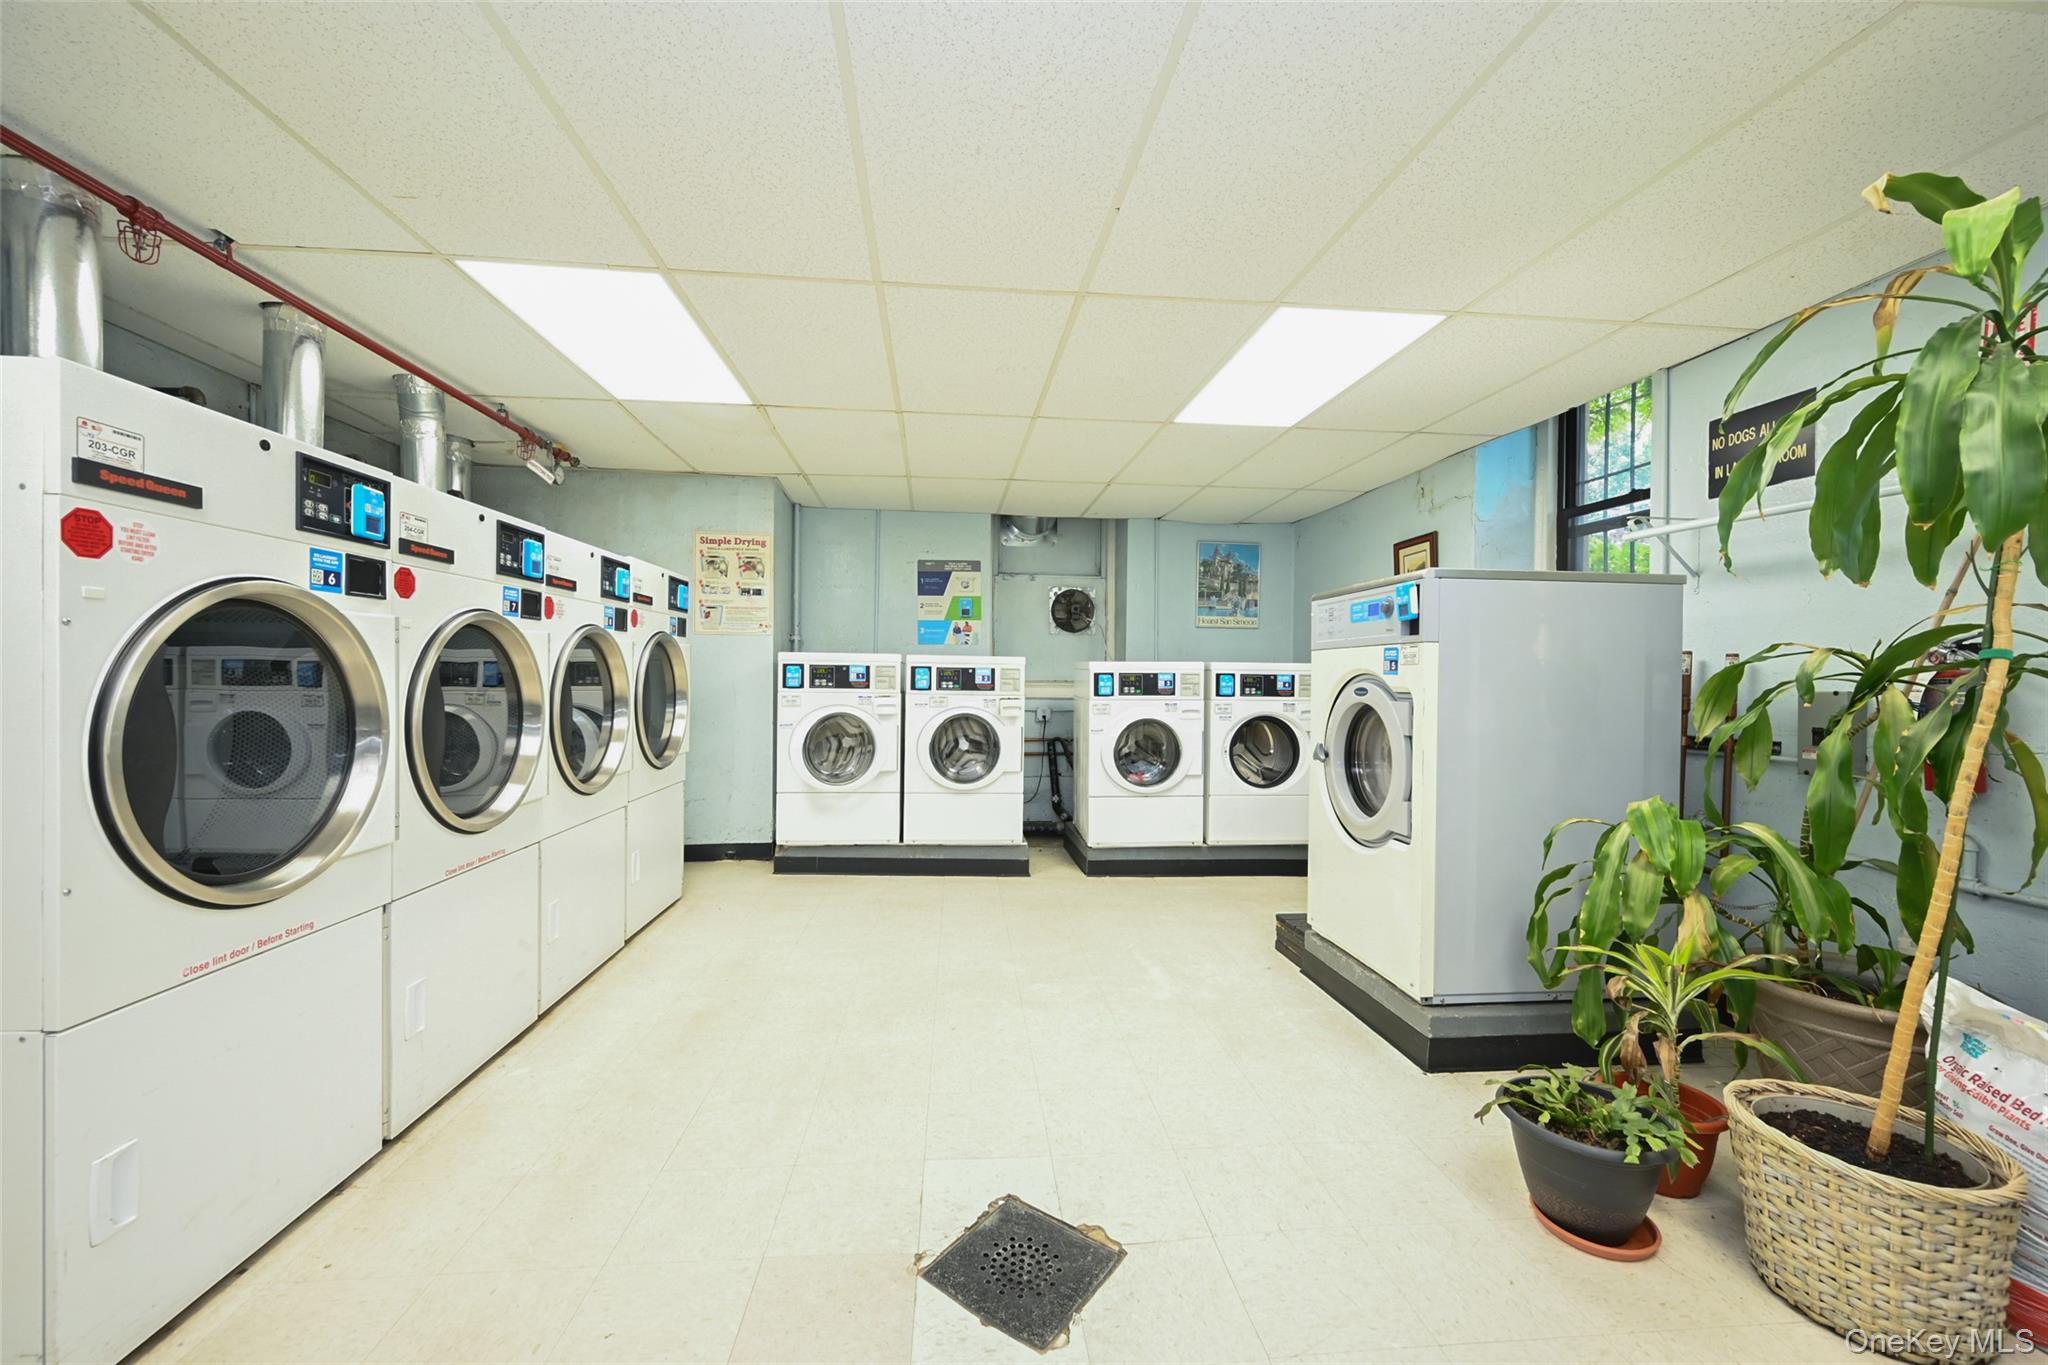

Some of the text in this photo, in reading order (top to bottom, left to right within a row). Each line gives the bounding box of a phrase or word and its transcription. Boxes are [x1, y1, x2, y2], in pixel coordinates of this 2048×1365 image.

[1712, 436, 1725, 451] NO
[1728, 427, 1756, 446] DOGS
[88, 439, 136, 459] 203-CGR
[1715, 465, 1724, 479] IN
[100, 468, 187, 498] Speed Queen
[75, 514, 101, 524] STOP
[699, 536, 767, 549] Simple Drying
[328, 573, 336, 585] 6
[511, 602, 517, 610] 7
[1391, 662, 1396, 670] 5
[182, 960, 210, 977] Close
[212, 953, 227, 966] lint
[229, 944, 250, 959] door
[257, 931, 284, 948] Before
[284, 921, 315, 938] Starting
[1968, 1072, 2012, 1104] Raised
[2009, 1096, 2041, 1123] Bed
[1997, 1106, 2032, 1132] Plants
[1988, 1124, 2004, 1138] Grow
